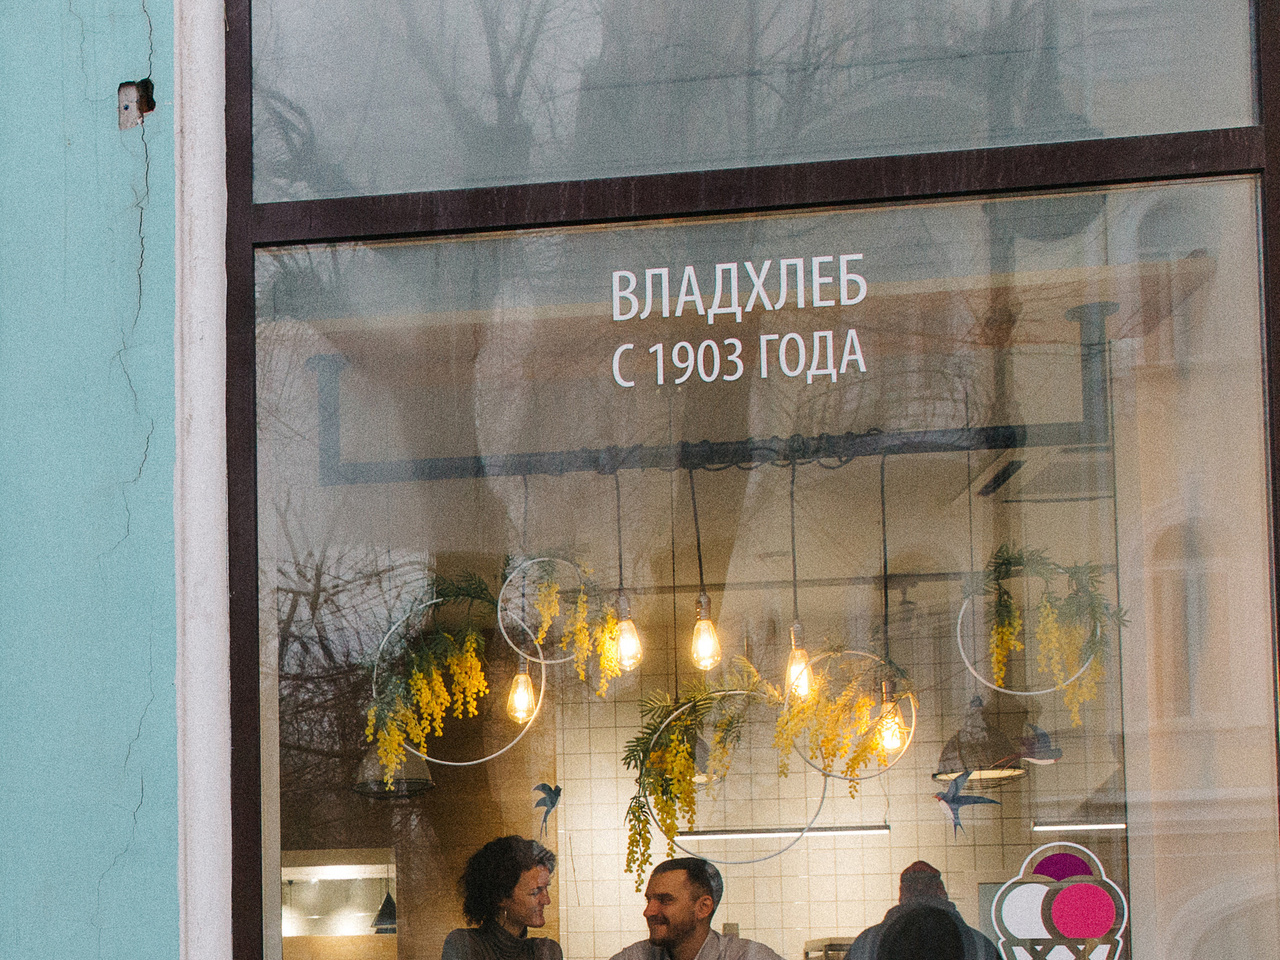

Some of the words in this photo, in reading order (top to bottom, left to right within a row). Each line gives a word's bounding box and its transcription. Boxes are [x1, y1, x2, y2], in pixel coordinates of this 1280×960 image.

[612, 253, 868, 325] ВЛАДХЛЕБ
[612, 343, 635, 387] С
[648, 337, 744, 385] 1903
[759, 328, 867, 384] ГОДА
